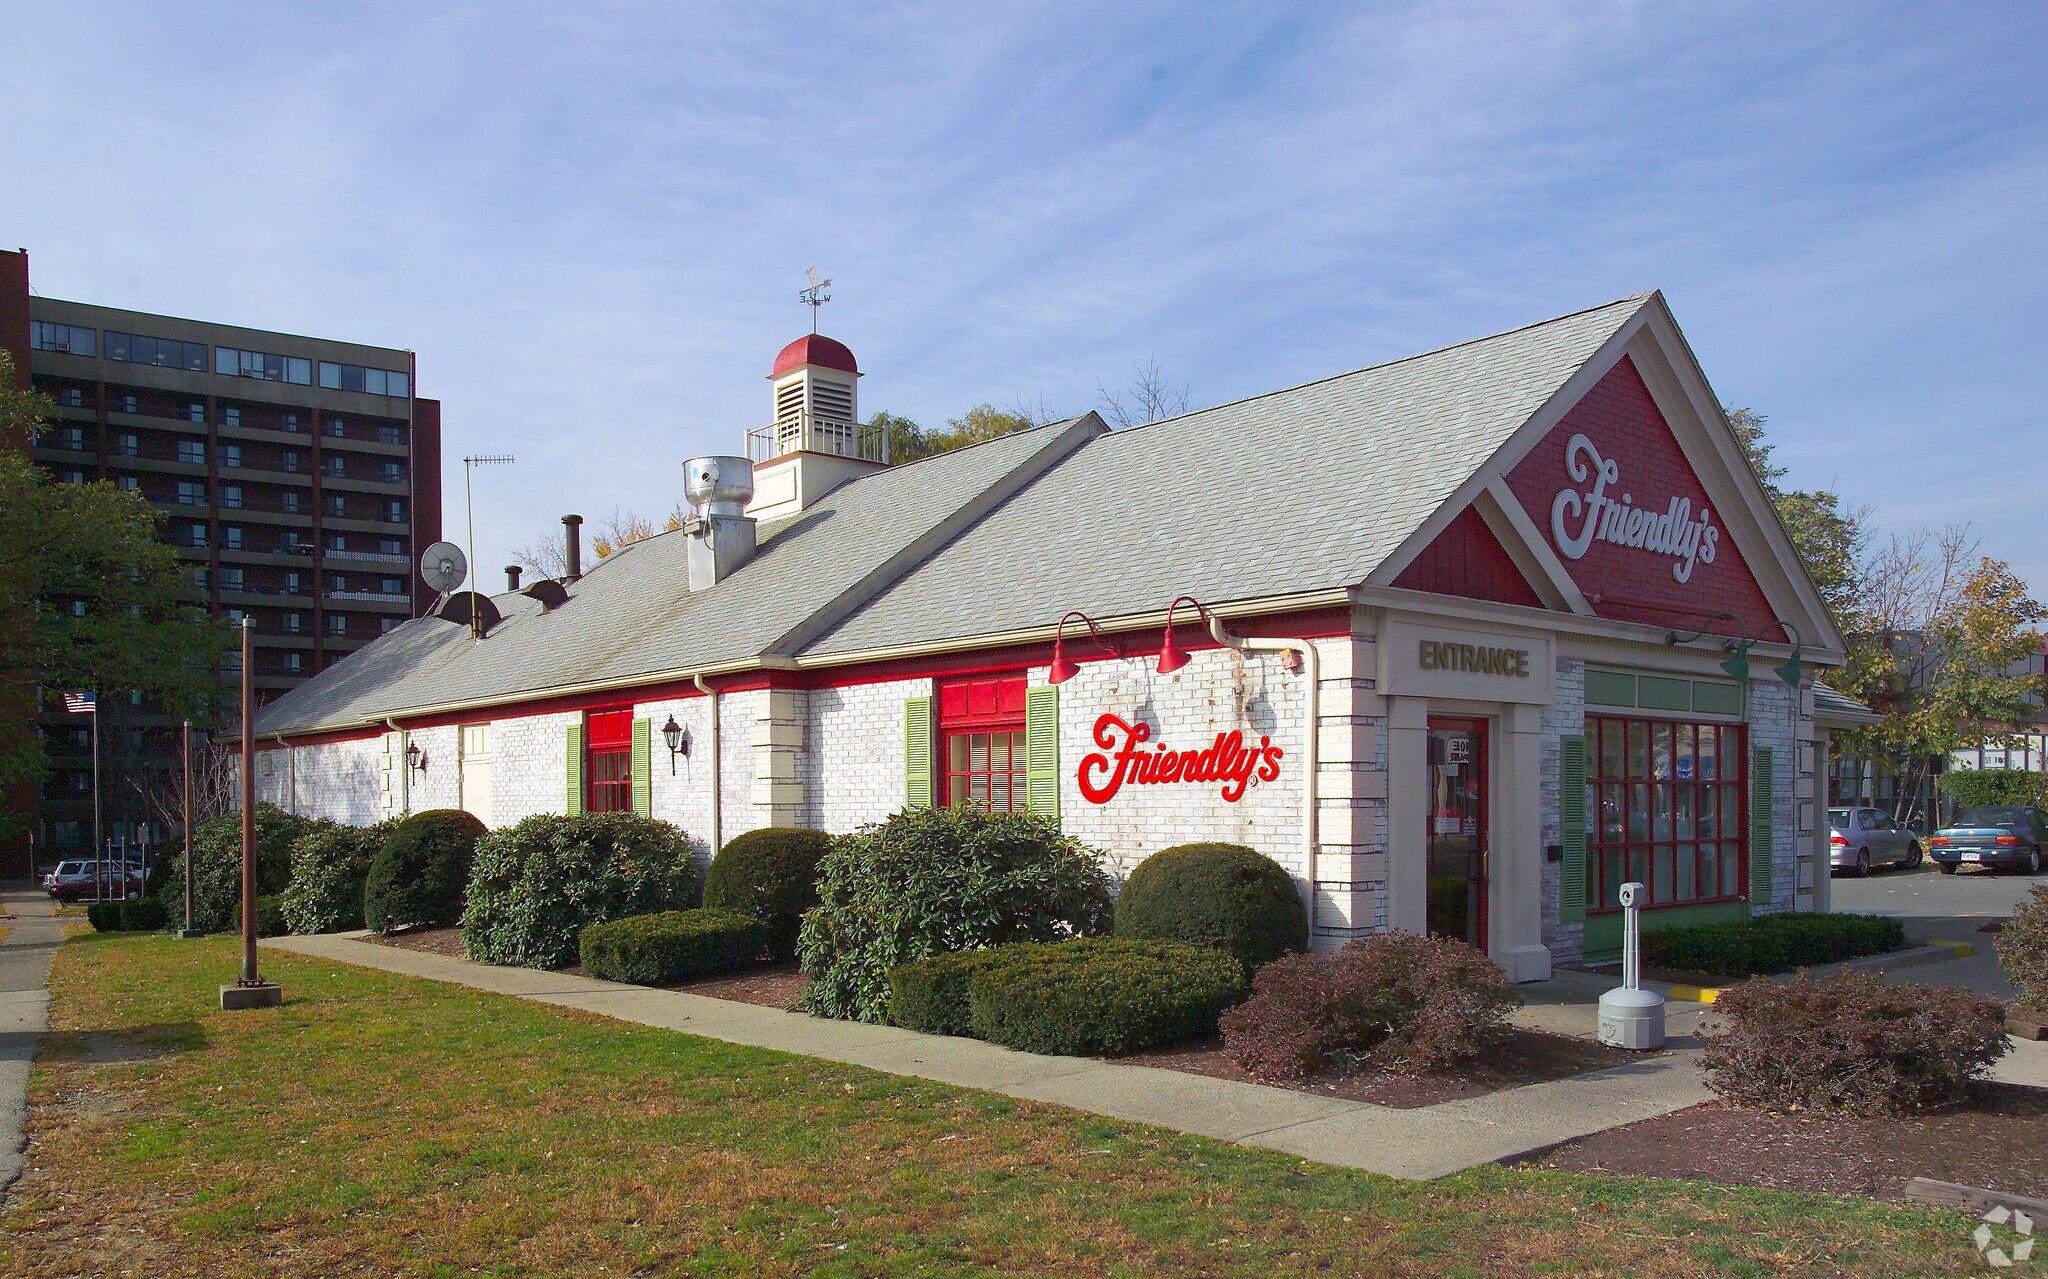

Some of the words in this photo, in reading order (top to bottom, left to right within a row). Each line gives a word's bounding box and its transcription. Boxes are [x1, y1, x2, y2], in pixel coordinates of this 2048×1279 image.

[1552, 433, 1718, 584] Friendly's
[1419, 639, 1530, 677] ENTRANCE
[1077, 712, 1283, 805] Friendly's
